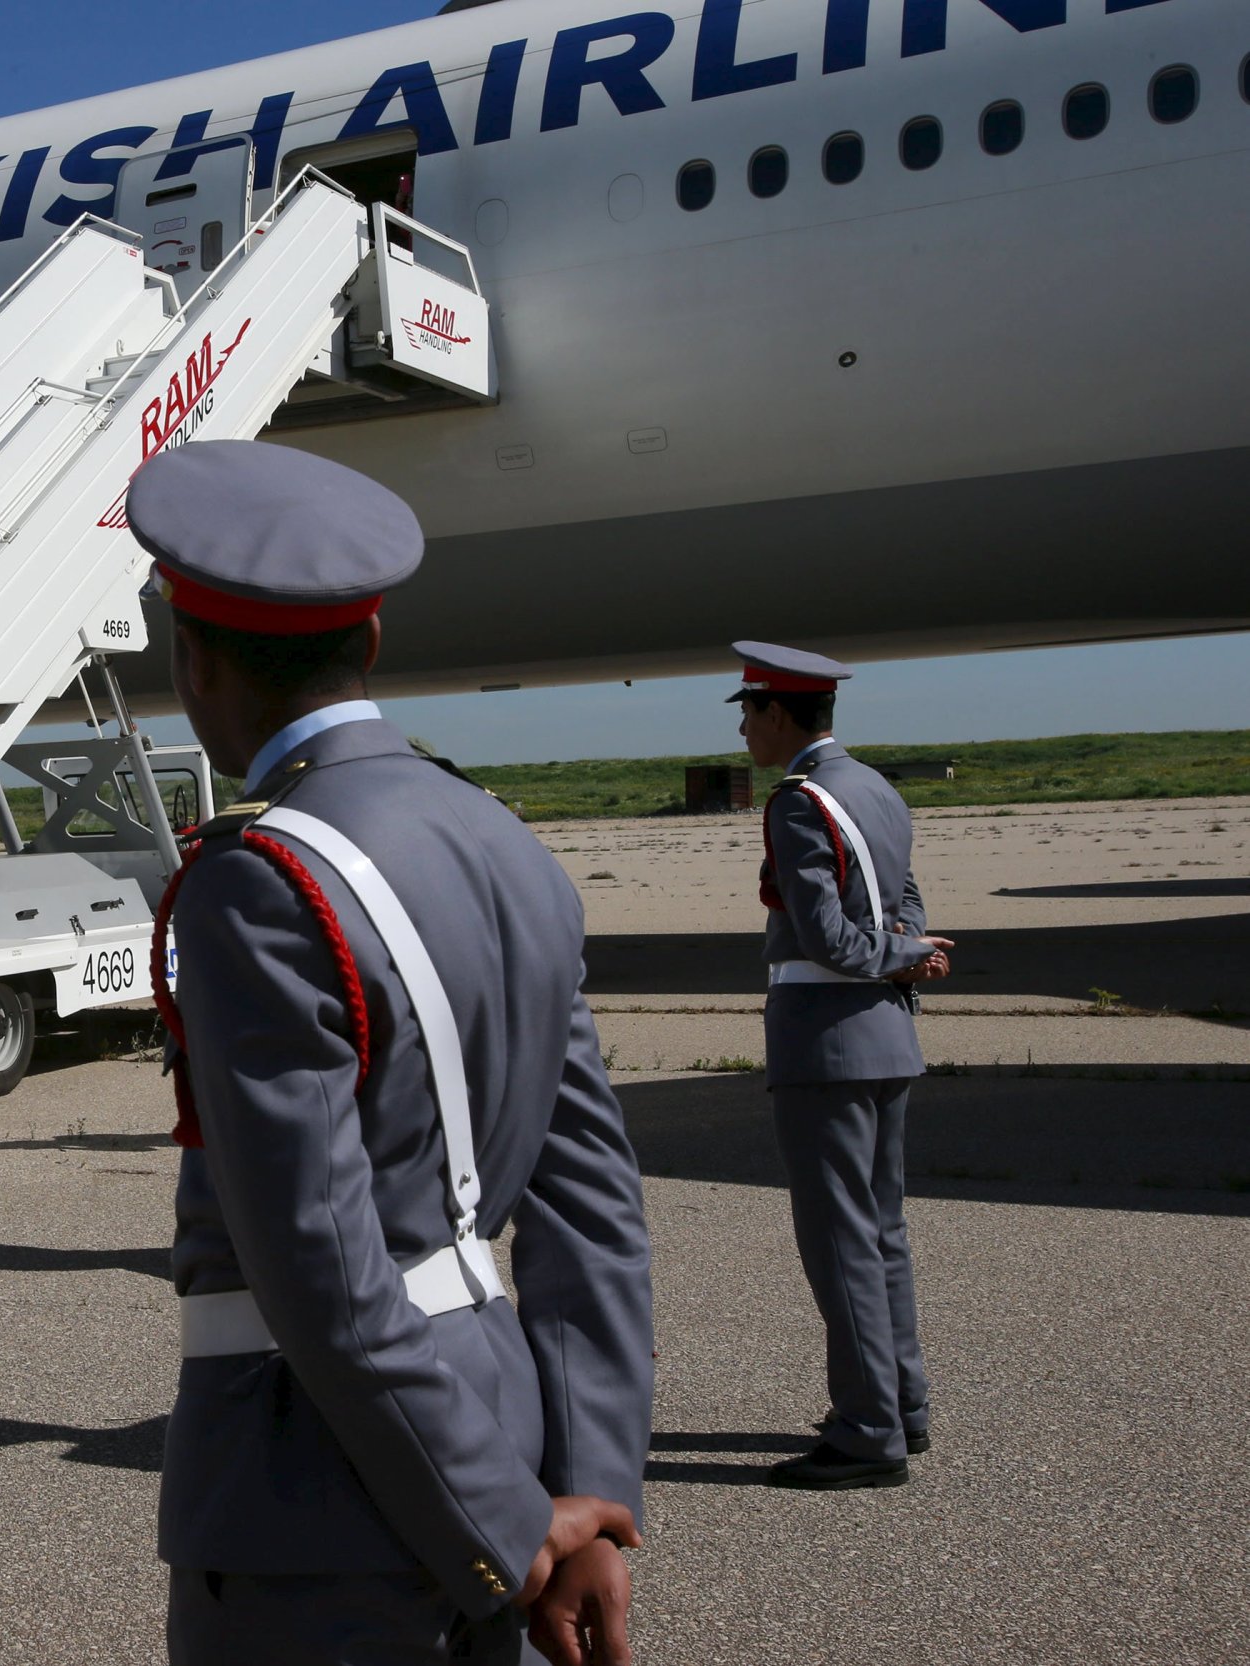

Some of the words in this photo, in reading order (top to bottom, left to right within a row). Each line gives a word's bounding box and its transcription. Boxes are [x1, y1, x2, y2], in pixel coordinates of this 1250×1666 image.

[421, 298, 455, 336] RAM
[419, 330, 452, 354] HANDLING
[141, 331, 211, 460] RAM
[103, 619, 130, 638] 4669
[83, 947, 134, 994] 4669
